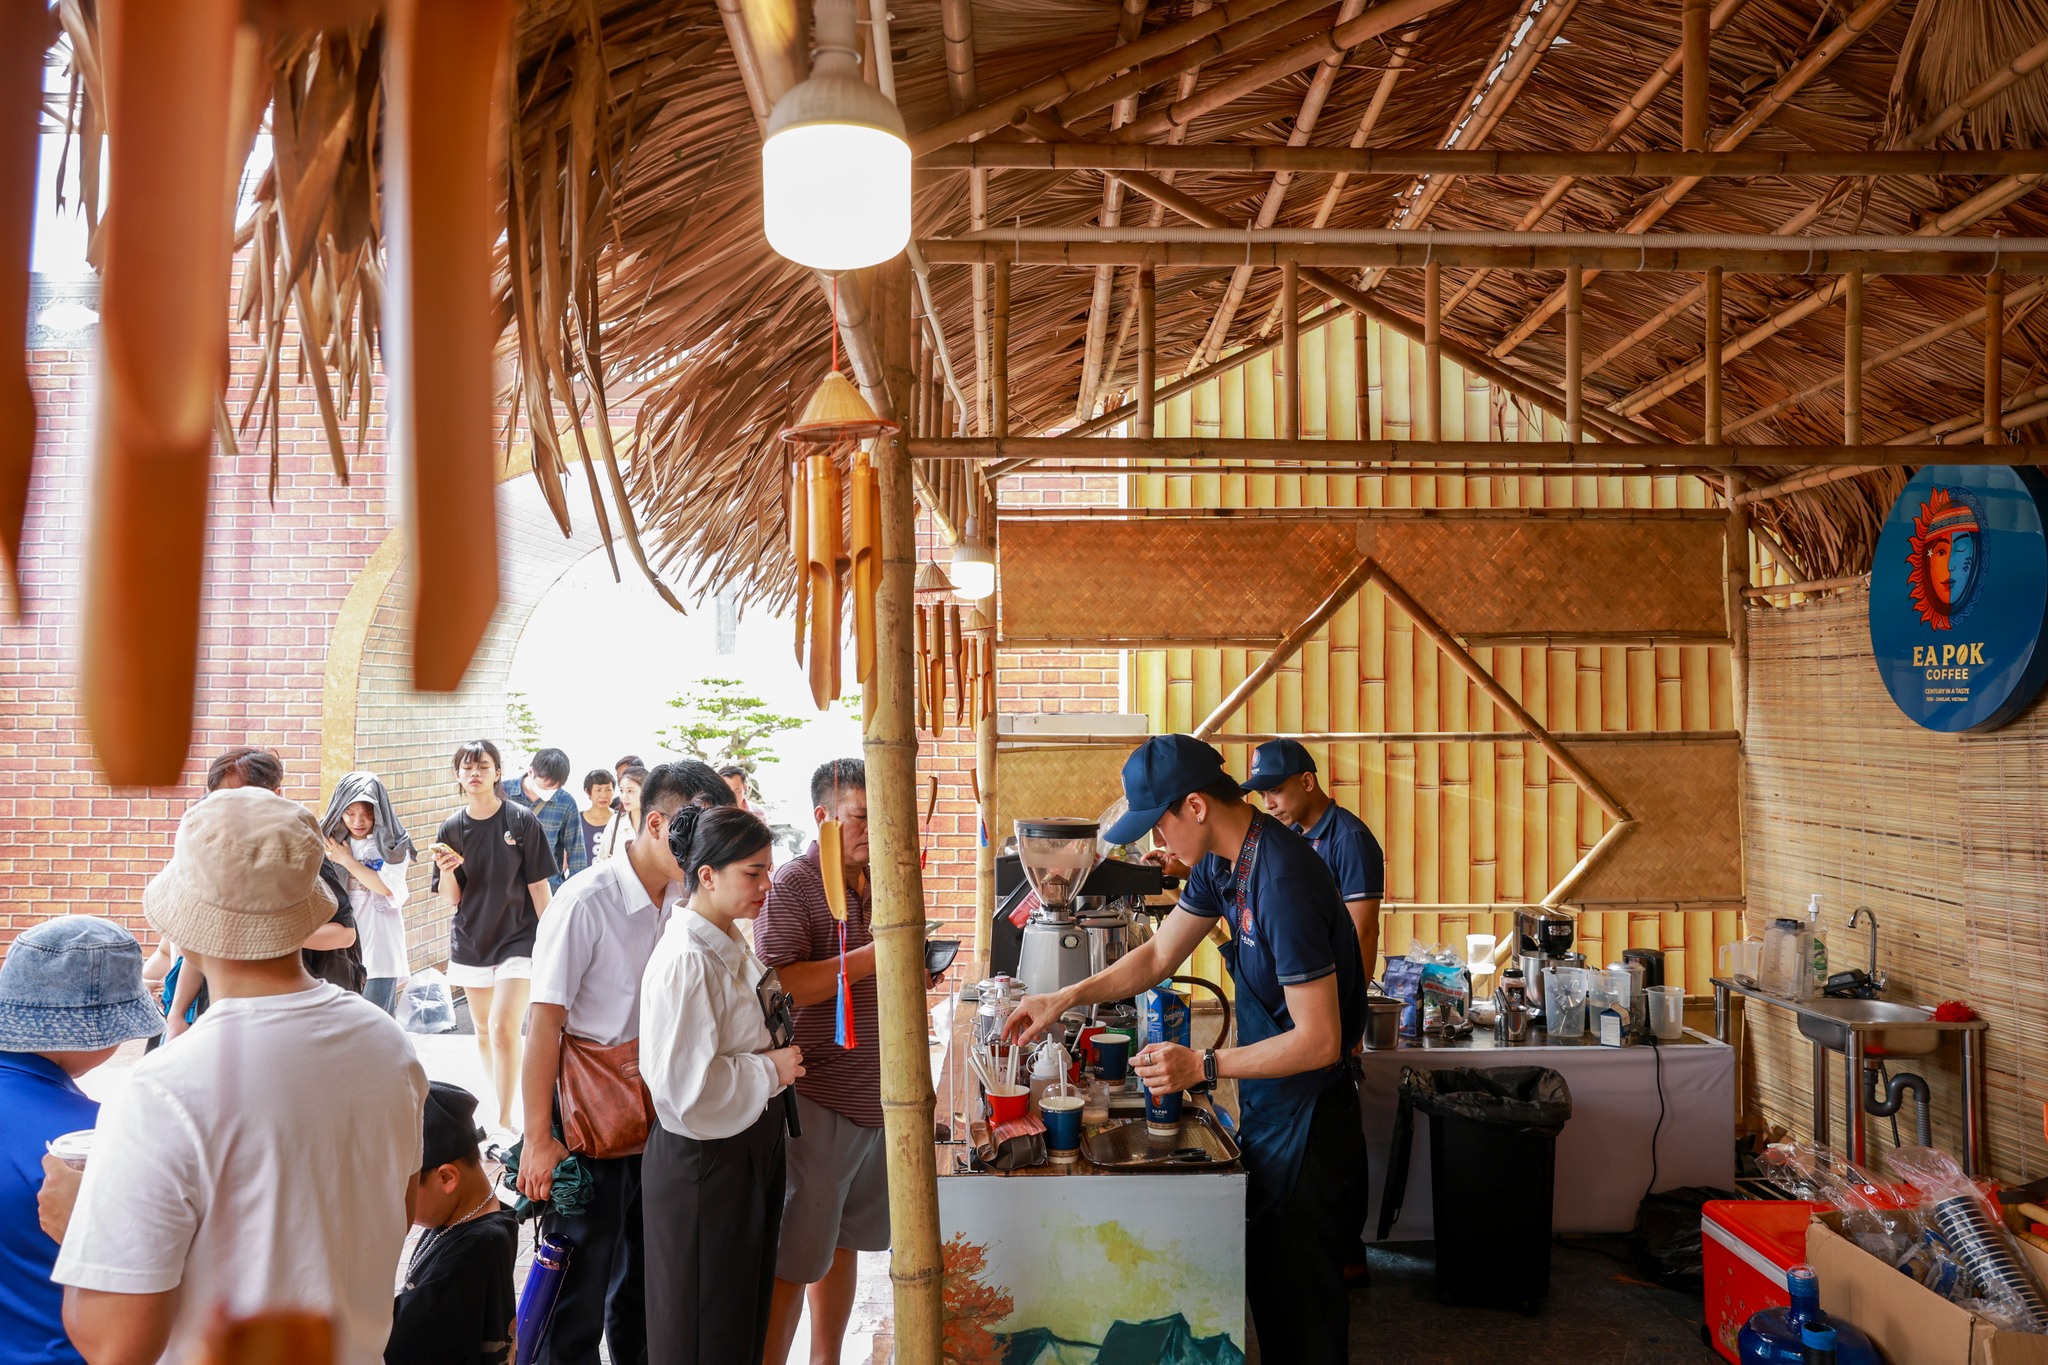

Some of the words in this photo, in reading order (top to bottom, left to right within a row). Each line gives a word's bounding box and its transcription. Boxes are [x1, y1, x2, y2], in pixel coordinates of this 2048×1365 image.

[1913, 646, 1938, 666] EA
[1942, 642, 1984, 665] POK
[1926, 668, 1968, 680] COFFEE
